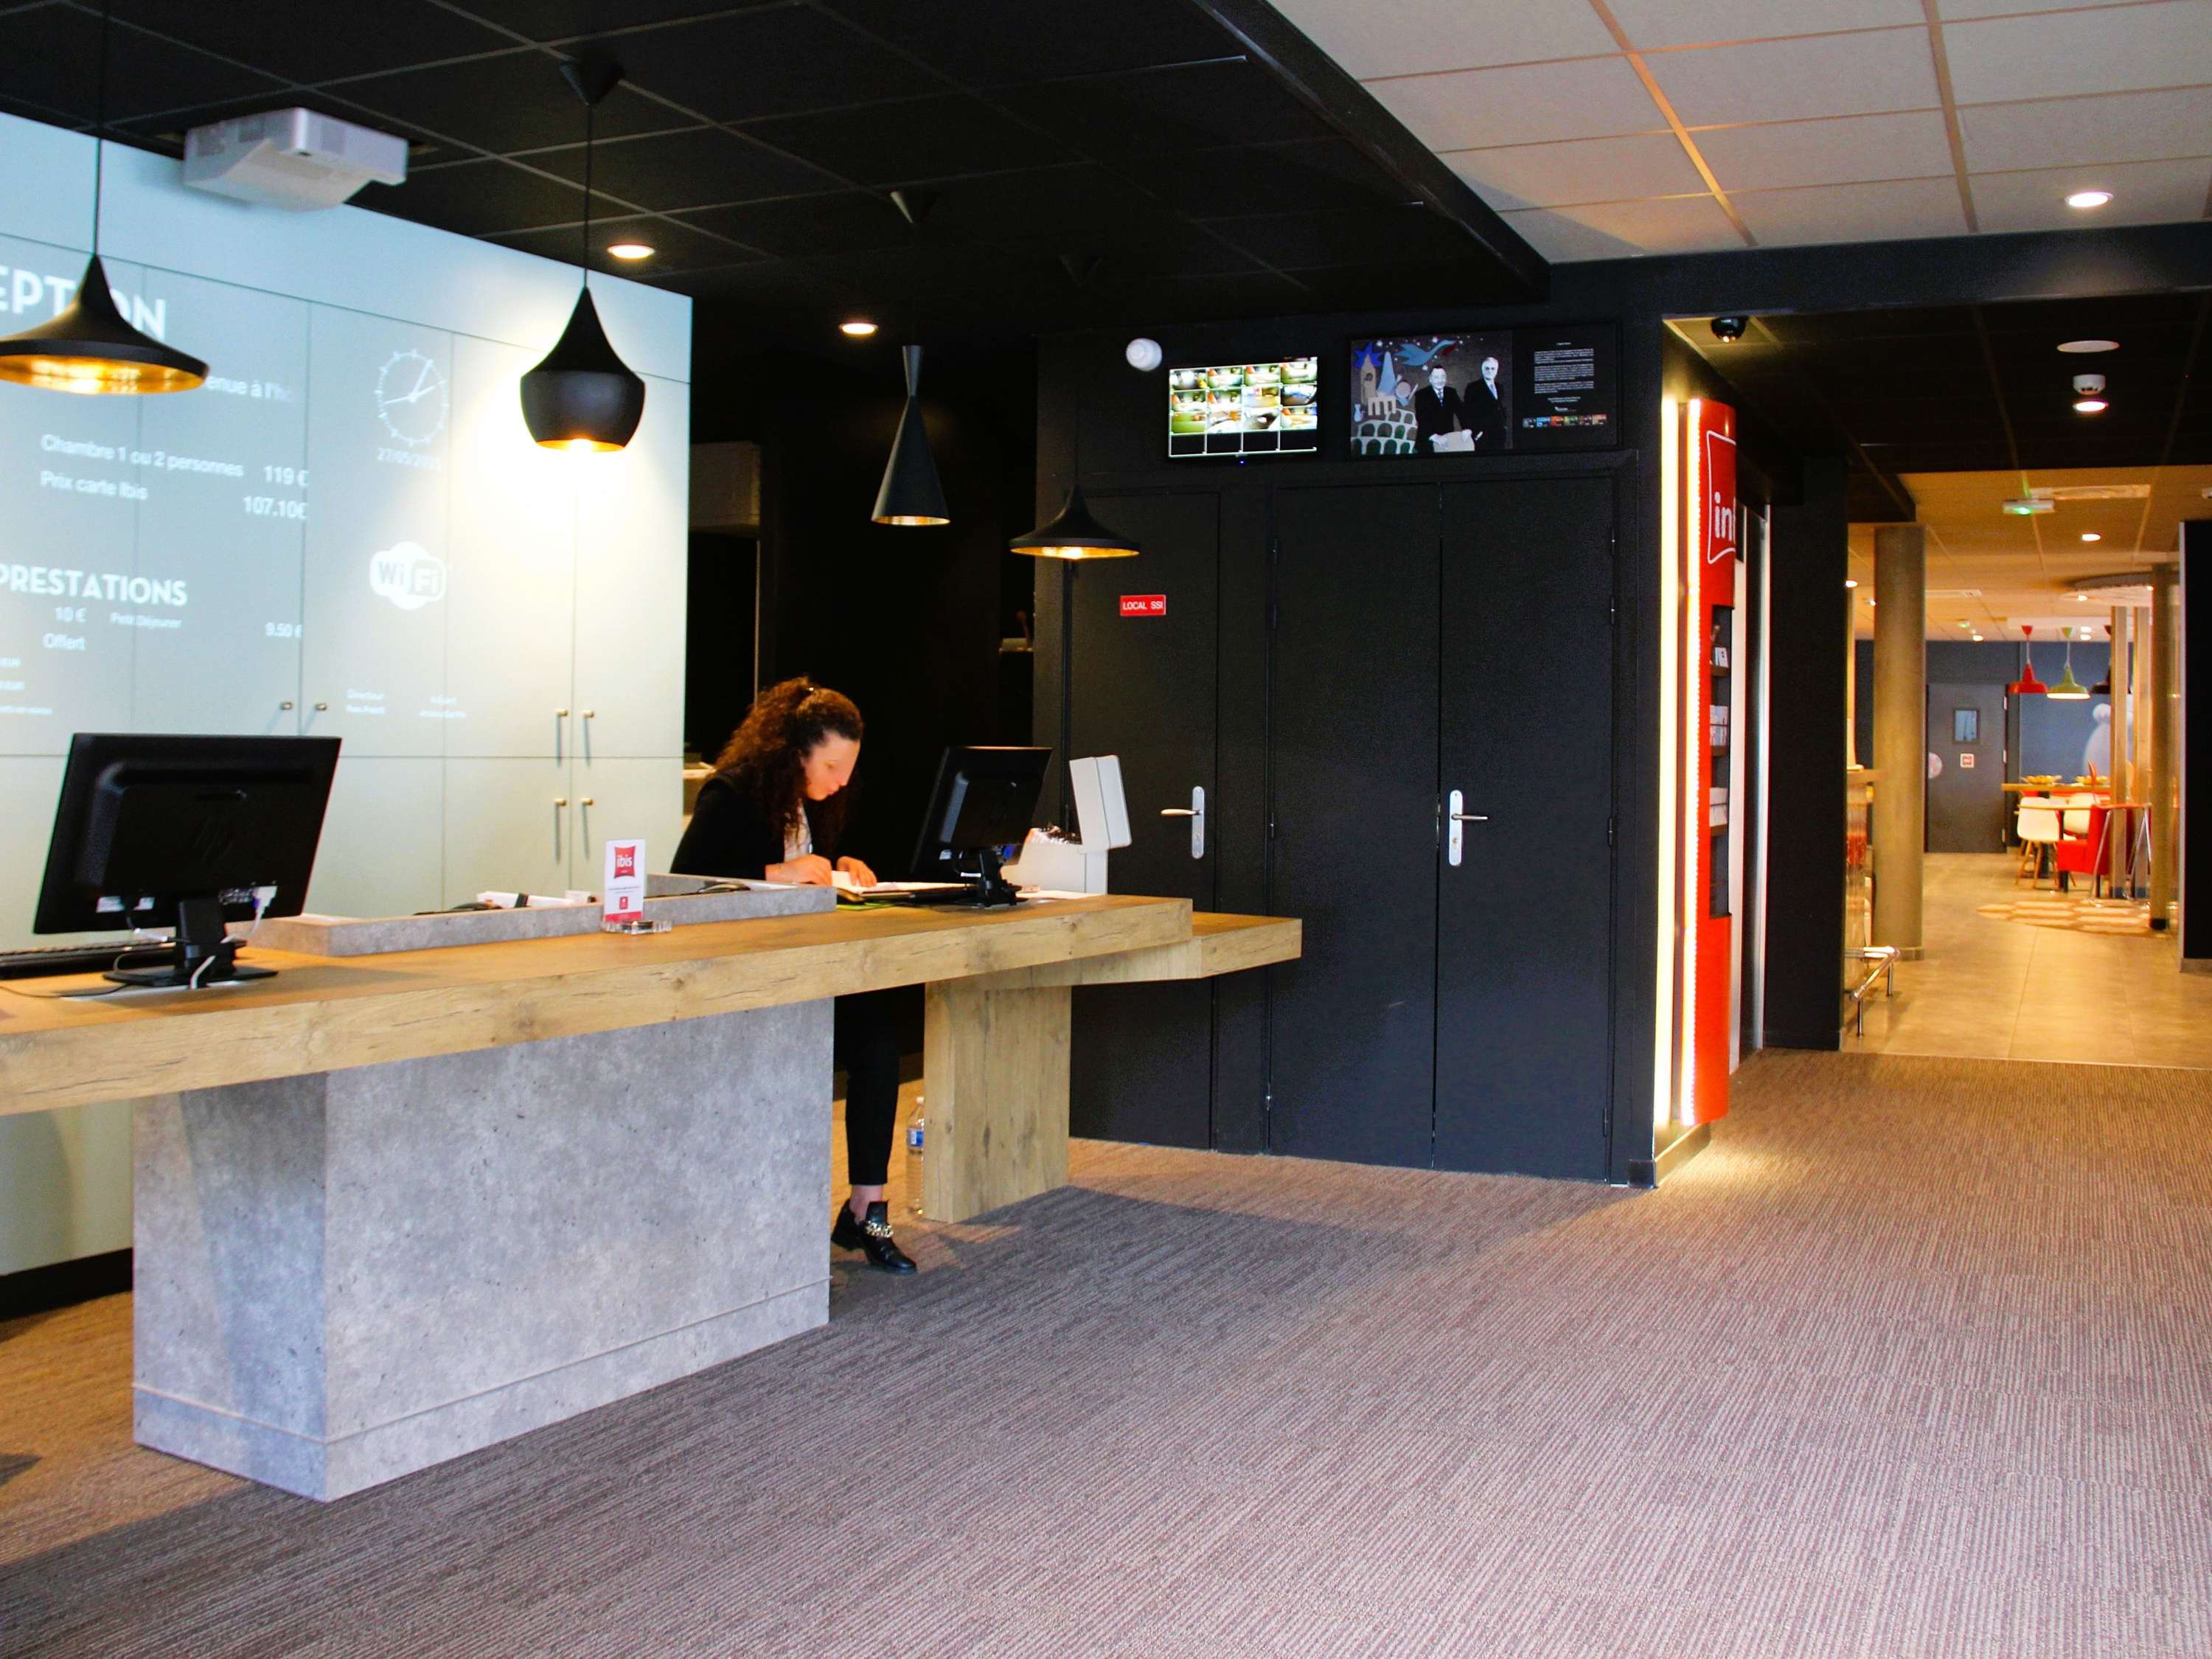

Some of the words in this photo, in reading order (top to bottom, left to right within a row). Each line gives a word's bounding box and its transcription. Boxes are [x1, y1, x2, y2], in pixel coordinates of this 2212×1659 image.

[41, 434, 115, 460] Chambre
[118, 446, 126, 462] 1
[130, 451, 152, 466] ou
[153, 451, 166, 467] 2
[166, 455, 243, 476] personnes
[40, 470, 73, 490] Prix
[75, 479, 118, 496] carte
[263, 465, 295, 485] 119
[1714, 491, 1736, 543] in
[1123, 601, 1147, 611] LOCAL
[1150, 600, 1164, 610] SSI
[616, 853, 633, 868] ibis
